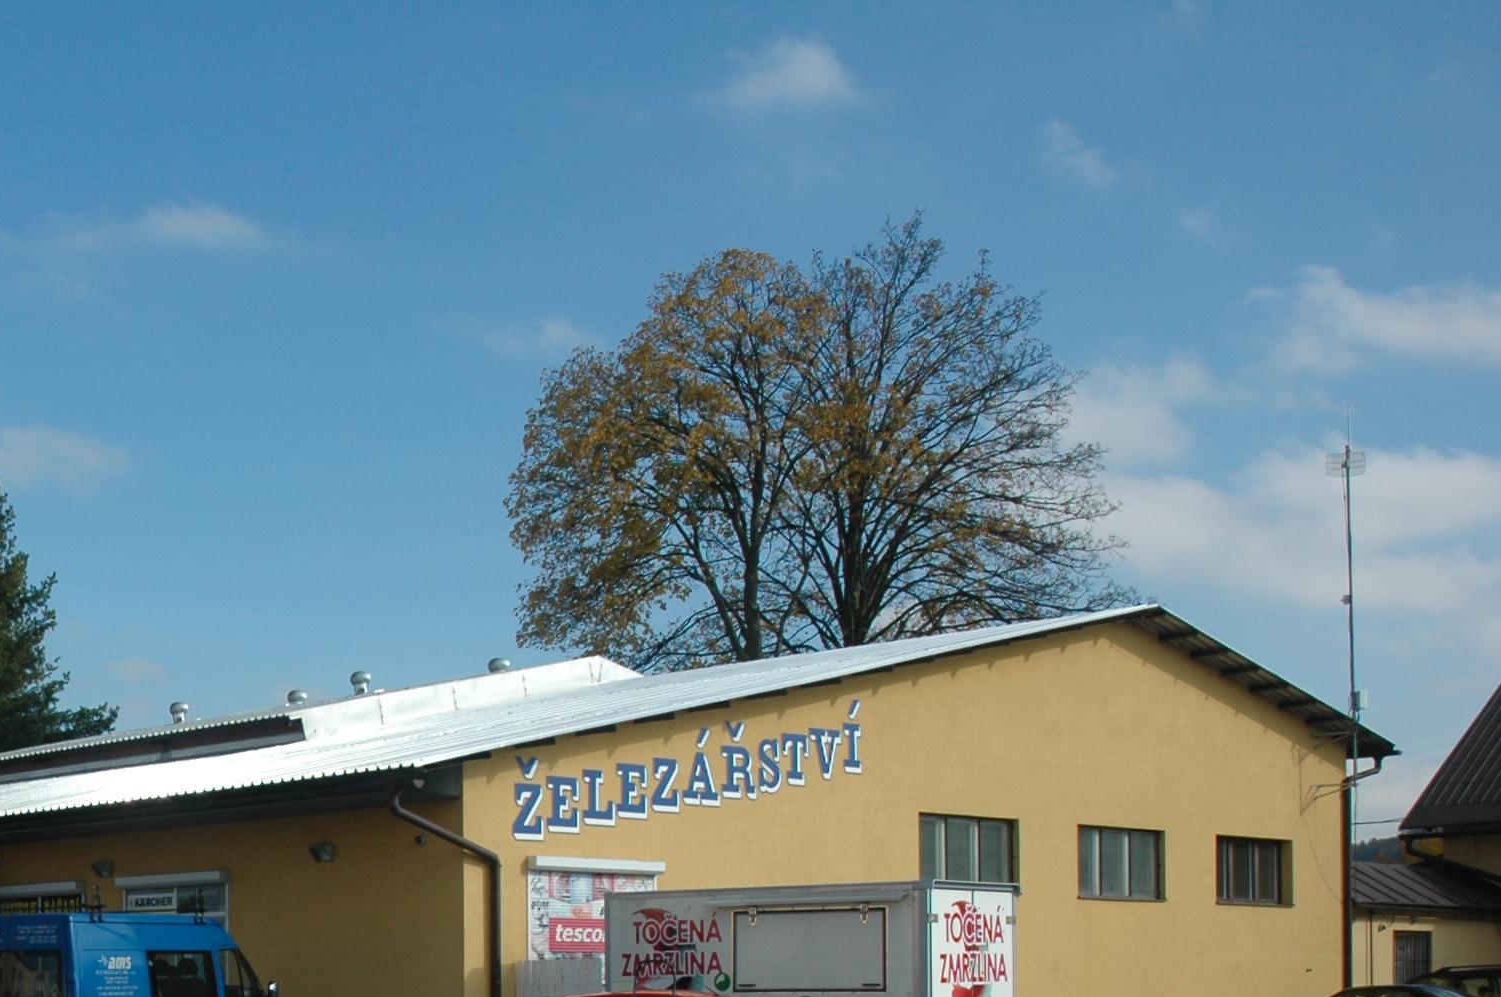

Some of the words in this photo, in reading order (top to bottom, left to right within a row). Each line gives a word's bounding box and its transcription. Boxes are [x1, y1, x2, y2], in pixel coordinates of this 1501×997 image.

[512, 699, 862, 841] ŽELEZÁŘSTVÍ
[555, 923, 606, 944] tesco
[632, 909, 722, 945] TOČENÁ
[943, 904, 1004, 944] TOČENÁ
[621, 951, 724, 977] ZMRZLINA
[940, 953, 1008, 984] ZMRZLINA
